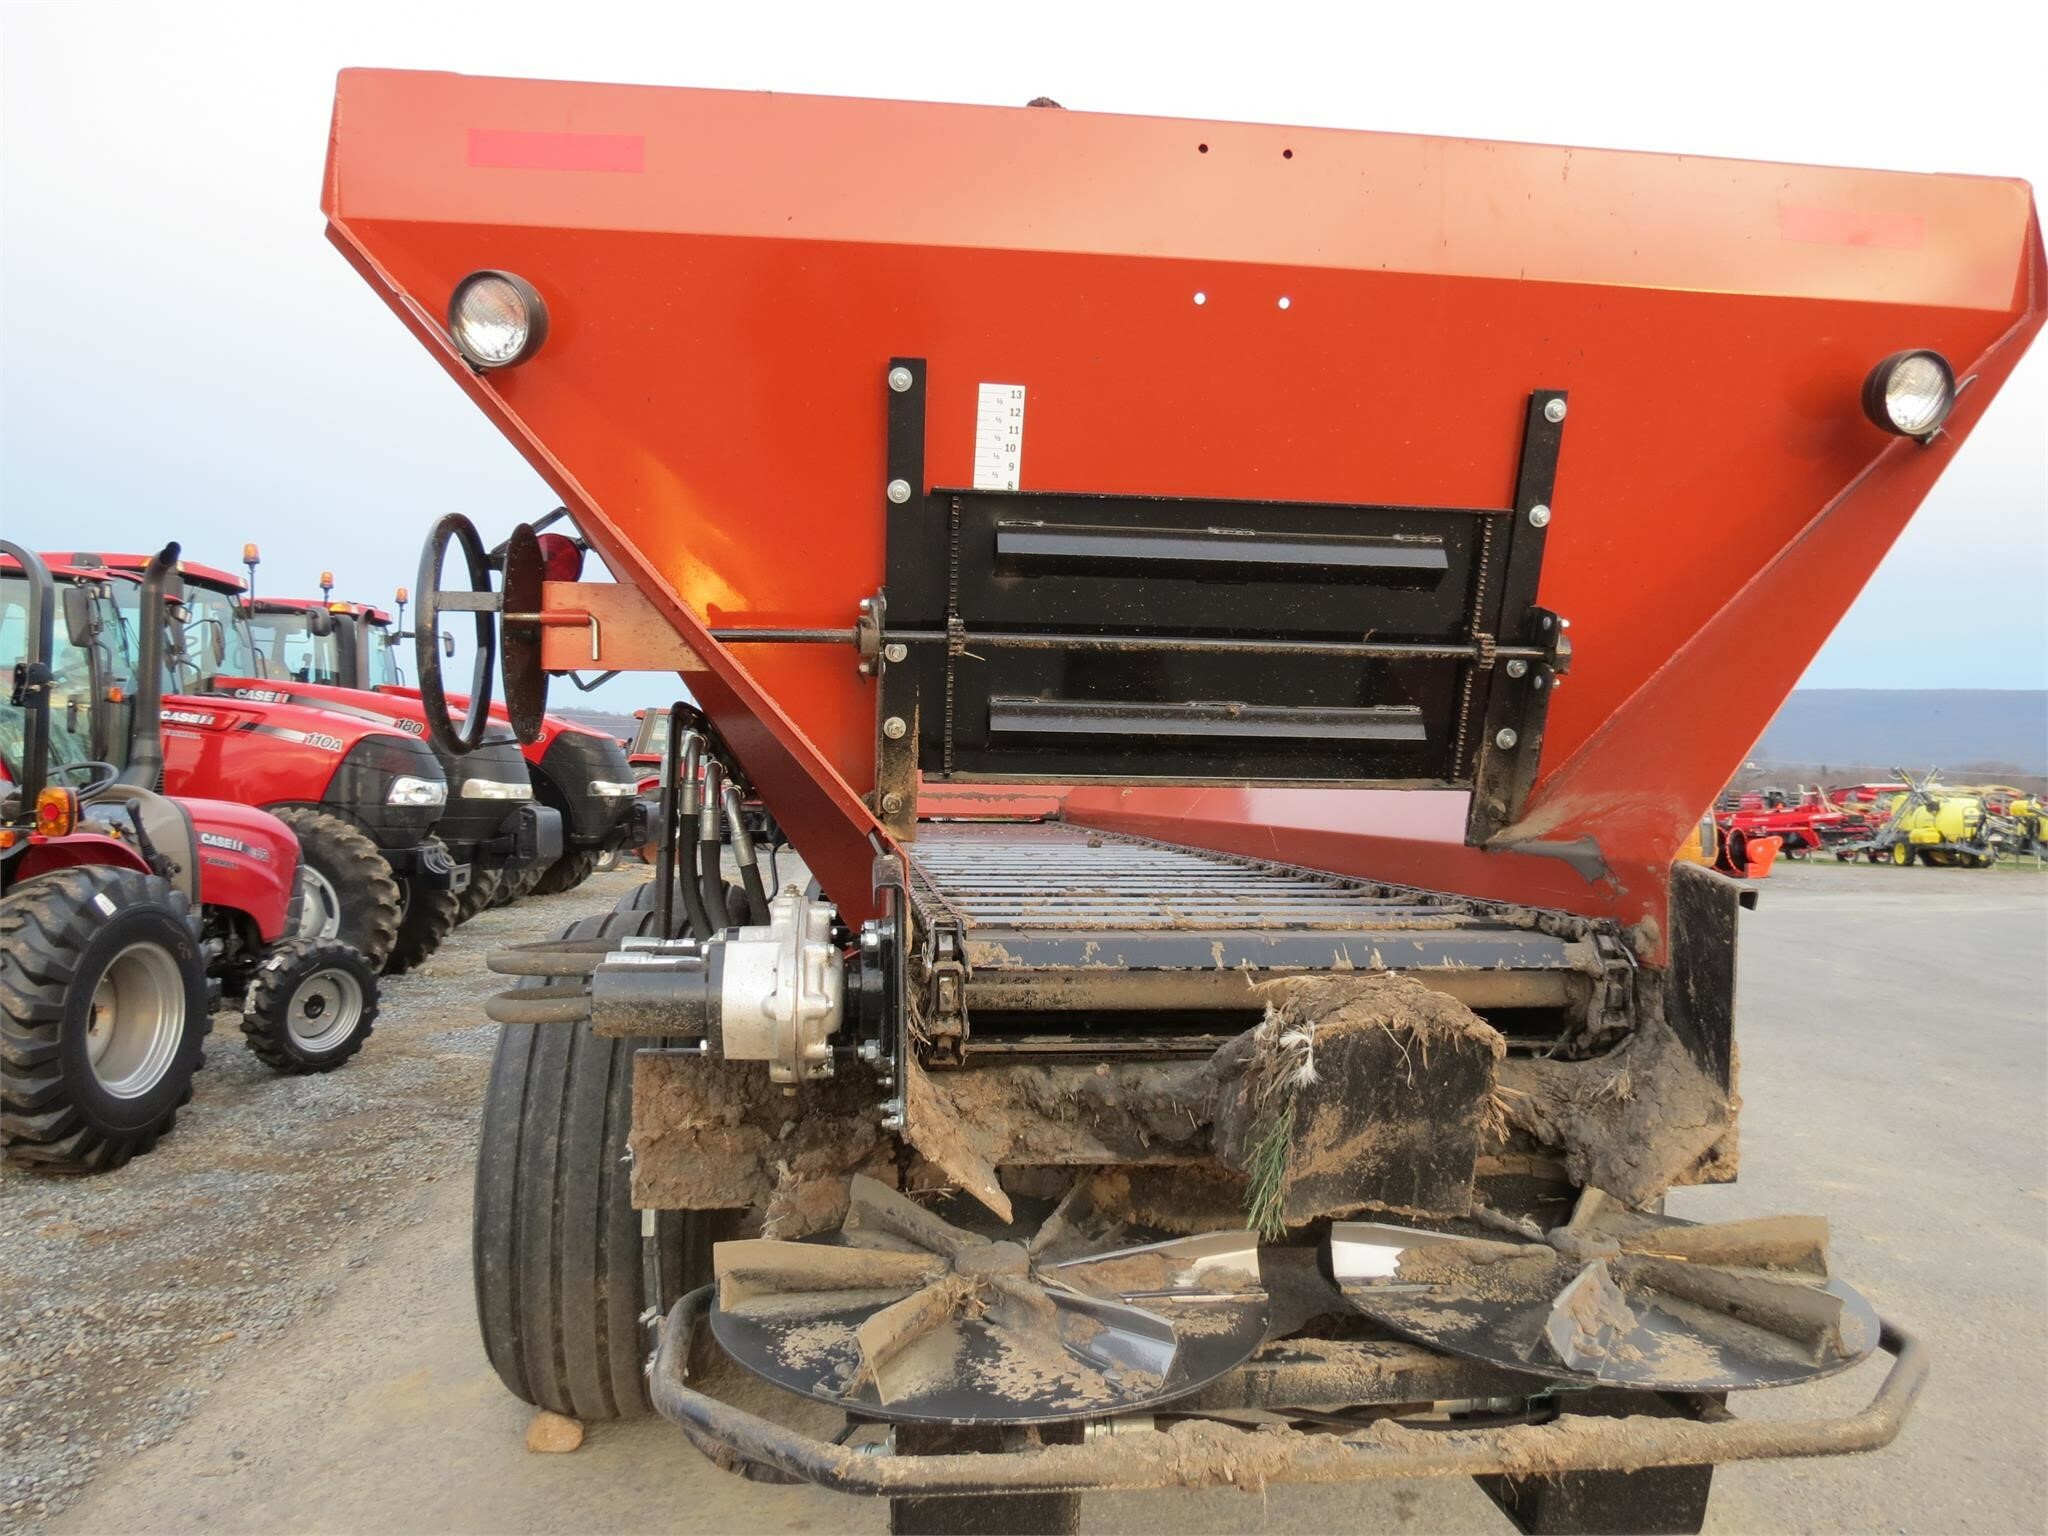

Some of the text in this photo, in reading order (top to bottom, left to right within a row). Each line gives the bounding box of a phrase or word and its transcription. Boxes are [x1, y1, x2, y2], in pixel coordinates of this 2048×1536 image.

[1011, 390, 1022, 399] 13
[1010, 408, 1021, 417] 12
[1008, 426, 1019, 435] 11
[1005, 444, 1016, 453] 10
[1009, 462, 1014, 471] 9
[398, 718, 424, 735] 180
[306, 732, 343, 752] 110A
